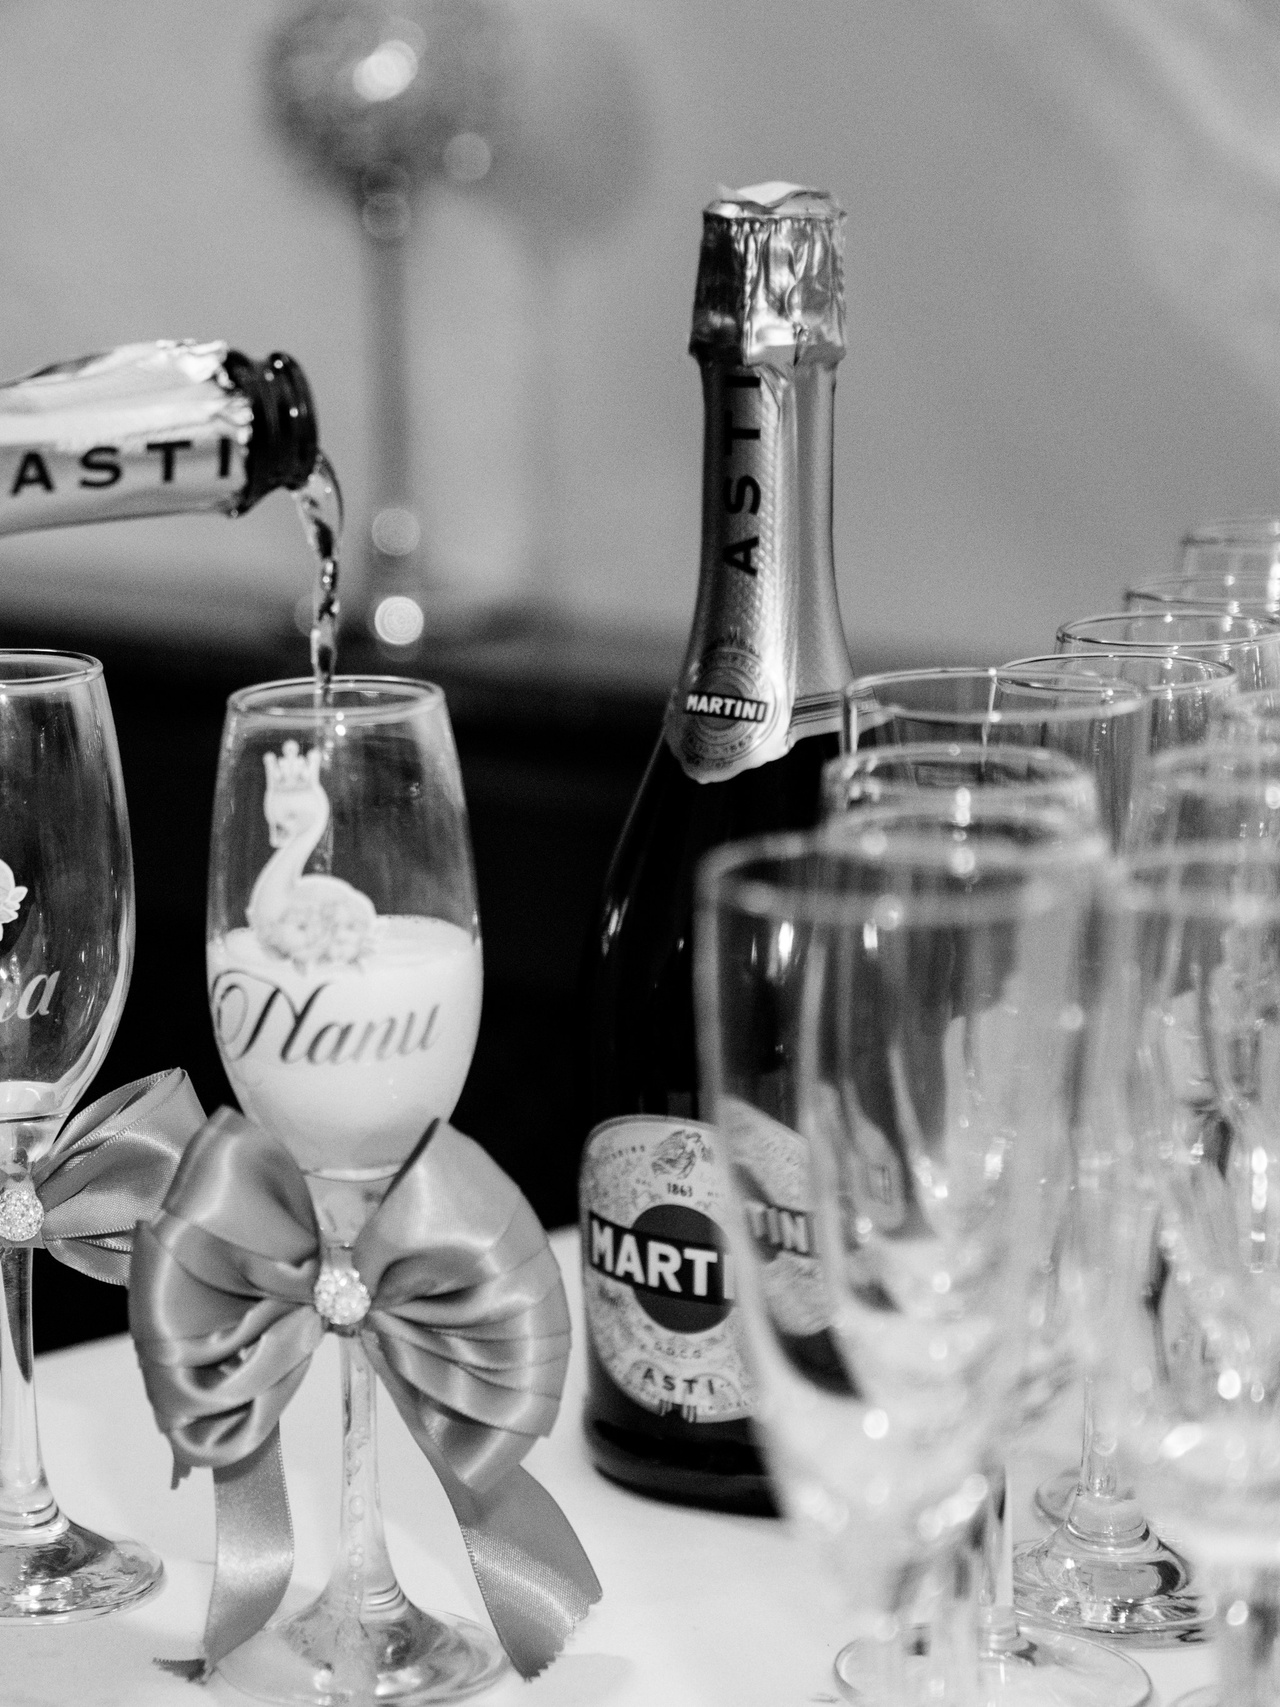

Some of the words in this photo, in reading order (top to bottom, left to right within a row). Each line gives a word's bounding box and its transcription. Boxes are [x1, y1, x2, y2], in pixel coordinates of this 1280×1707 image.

[11, 437, 233, 496] ASTI
[723, 374, 761, 577] ASTI
[686, 694, 766, 721] MARTINI
[666, 1182, 694, 1198] 1863
[641, 1367, 715, 1396] ASTI
